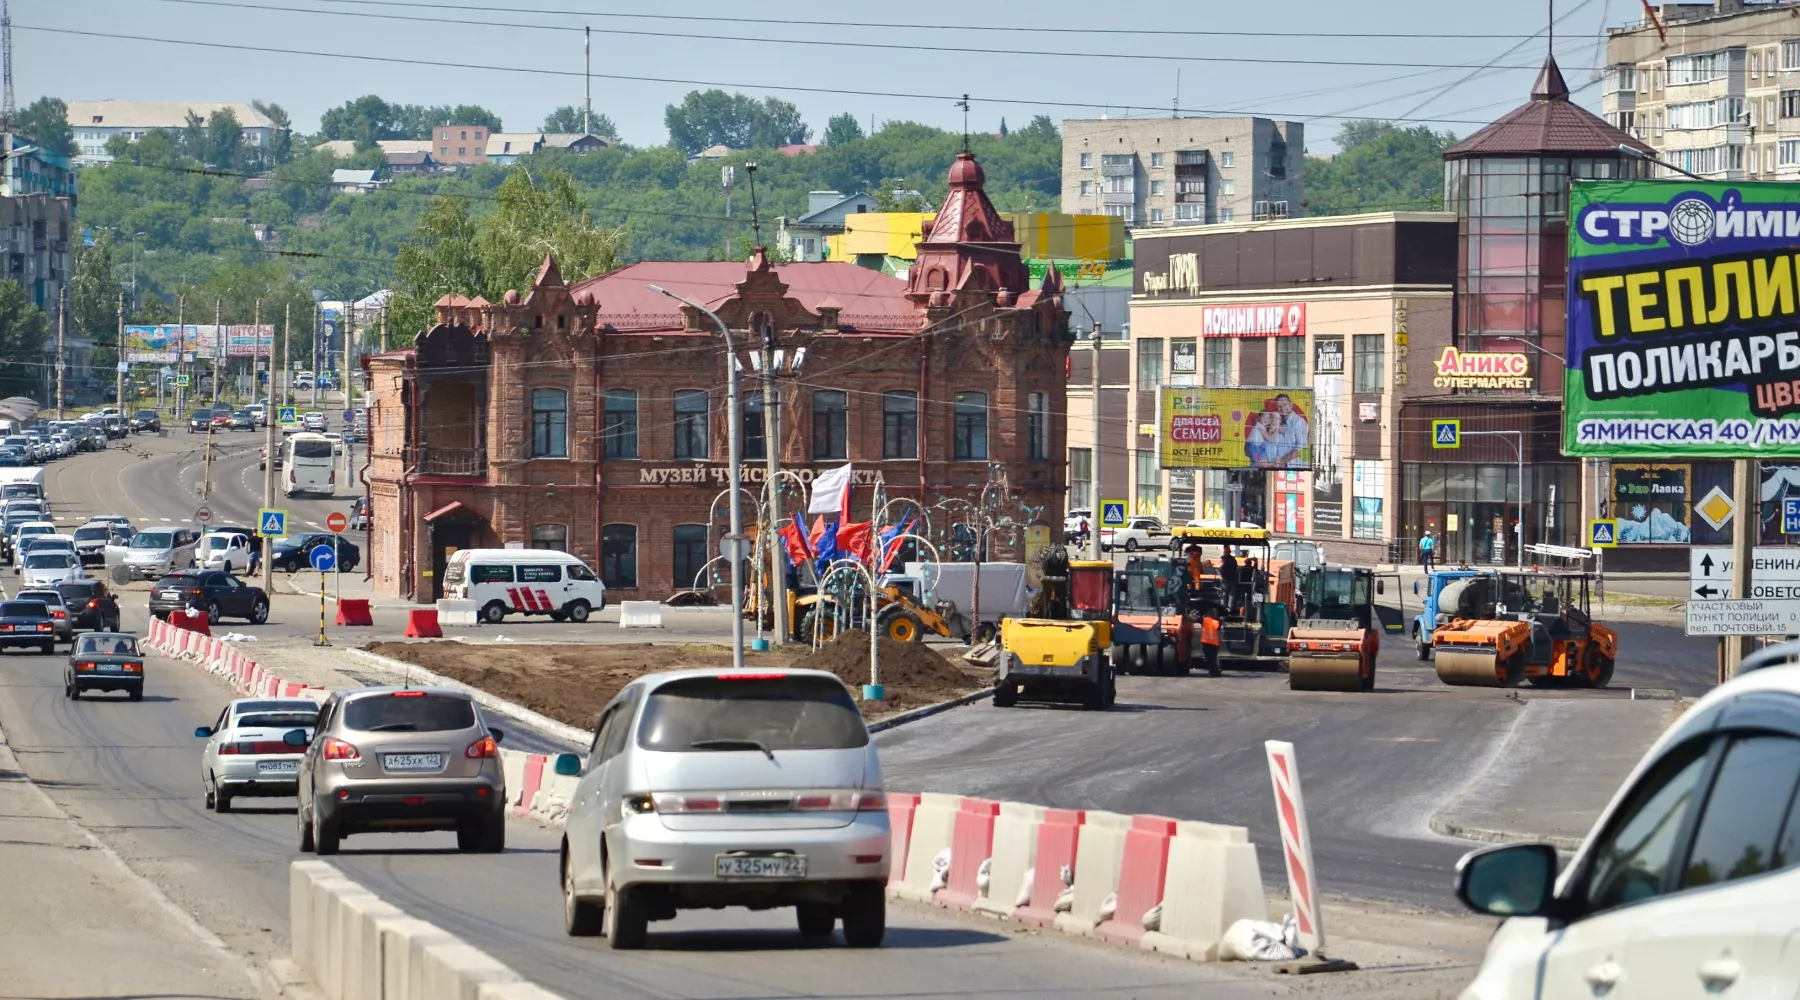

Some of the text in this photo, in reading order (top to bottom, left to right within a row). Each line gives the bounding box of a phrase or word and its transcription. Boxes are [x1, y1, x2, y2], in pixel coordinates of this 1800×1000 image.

[1256, 305, 1284, 332] МИР
[1433, 377, 1533, 389] СУПЕРМАРКЕТ
[1173, 416, 1219, 426] ДЛЯ ВСЕЙ
[1172, 427, 1220, 440] СЕМЬИ
[1582, 423, 1713, 440] ЯМИНСКАЯ
[1719, 423, 1749, 440] 40
[1192, 447, 1223, 457] ЦЕНТР
[640, 464, 706, 483] МУЗЕЙ
[1652, 484, 1684, 493] Лавка
[1691, 602, 1763, 611] УЧАСТКОВЫЙ
[1690, 613, 1724, 621] ПУНКТ
[1728, 613, 1779, 622] ПОЛИЦИИ
